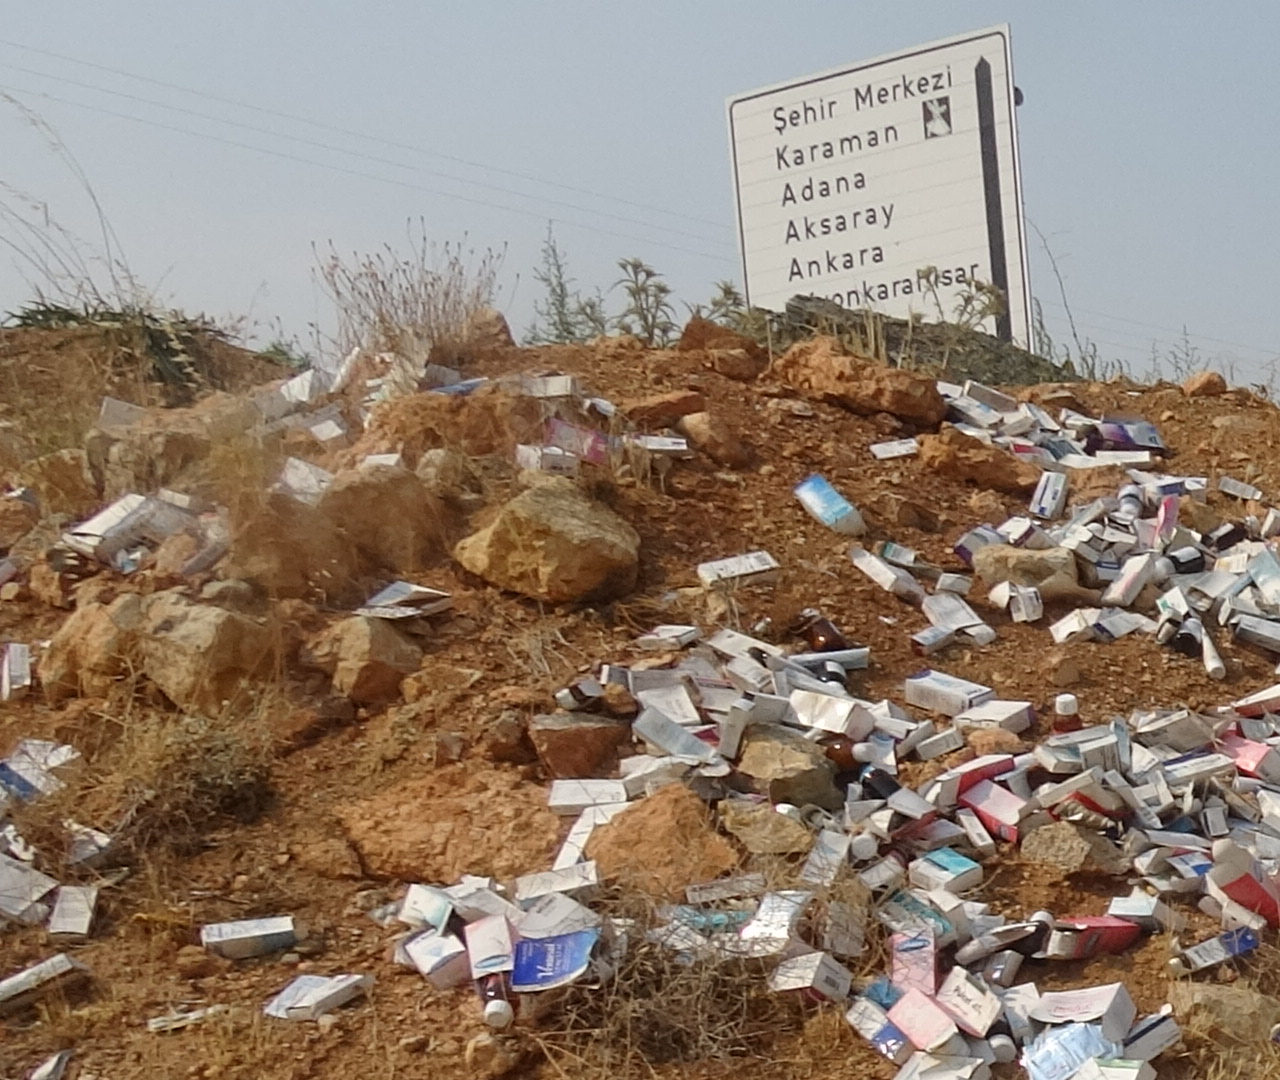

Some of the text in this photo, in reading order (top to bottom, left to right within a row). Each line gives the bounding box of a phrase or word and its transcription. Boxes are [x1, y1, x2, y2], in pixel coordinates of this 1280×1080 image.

[773, 65, 952, 136] Şehir Merkezi
[776, 125, 898, 170] Karaman
[782, 172, 866, 207] Adana
[785, 204, 894, 244] Aksaray
[788, 246, 884, 282] Ankara
